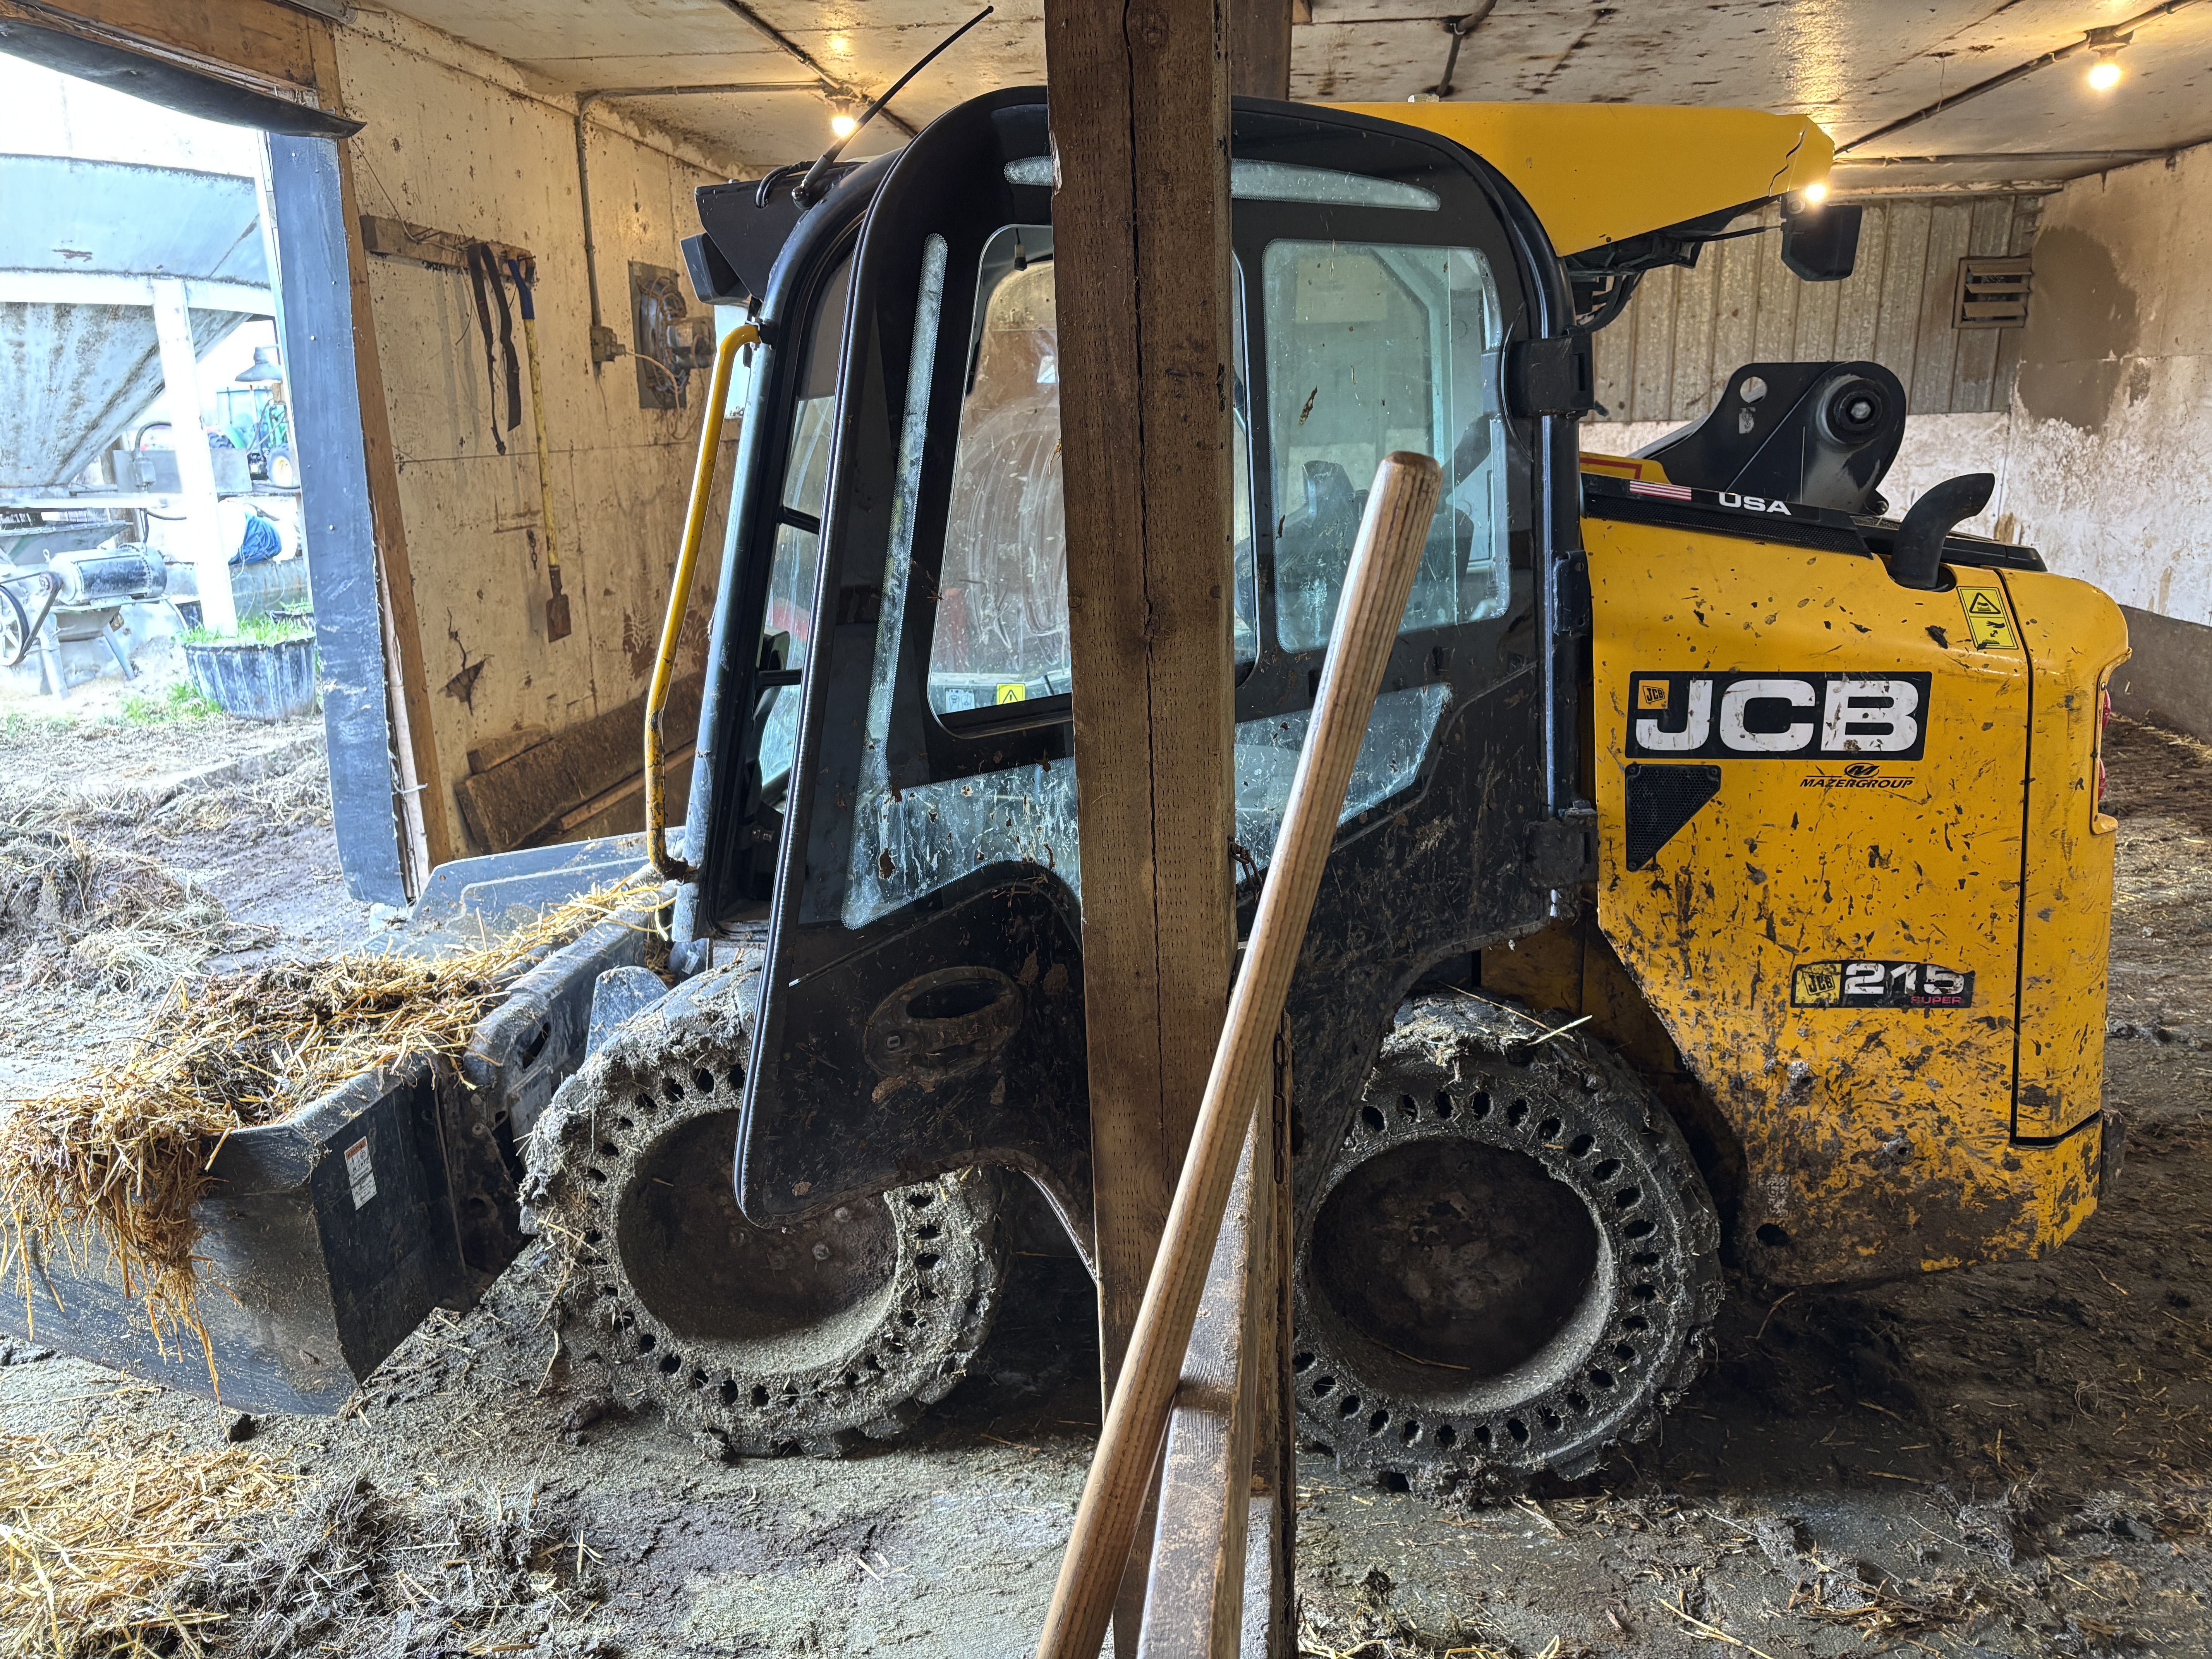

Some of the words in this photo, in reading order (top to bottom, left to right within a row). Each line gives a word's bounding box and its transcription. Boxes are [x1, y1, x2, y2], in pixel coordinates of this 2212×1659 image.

[1719, 492, 1792, 515] USA
[1647, 688, 1664, 701] JCB
[1636, 680, 1918, 751] JCB
[1800, 779, 1913, 788] MAZERGROUP
[1808, 974, 1834, 993] JCB
[1844, 963, 1964, 994] 215
[1911, 996, 1962, 1004] SUPER
